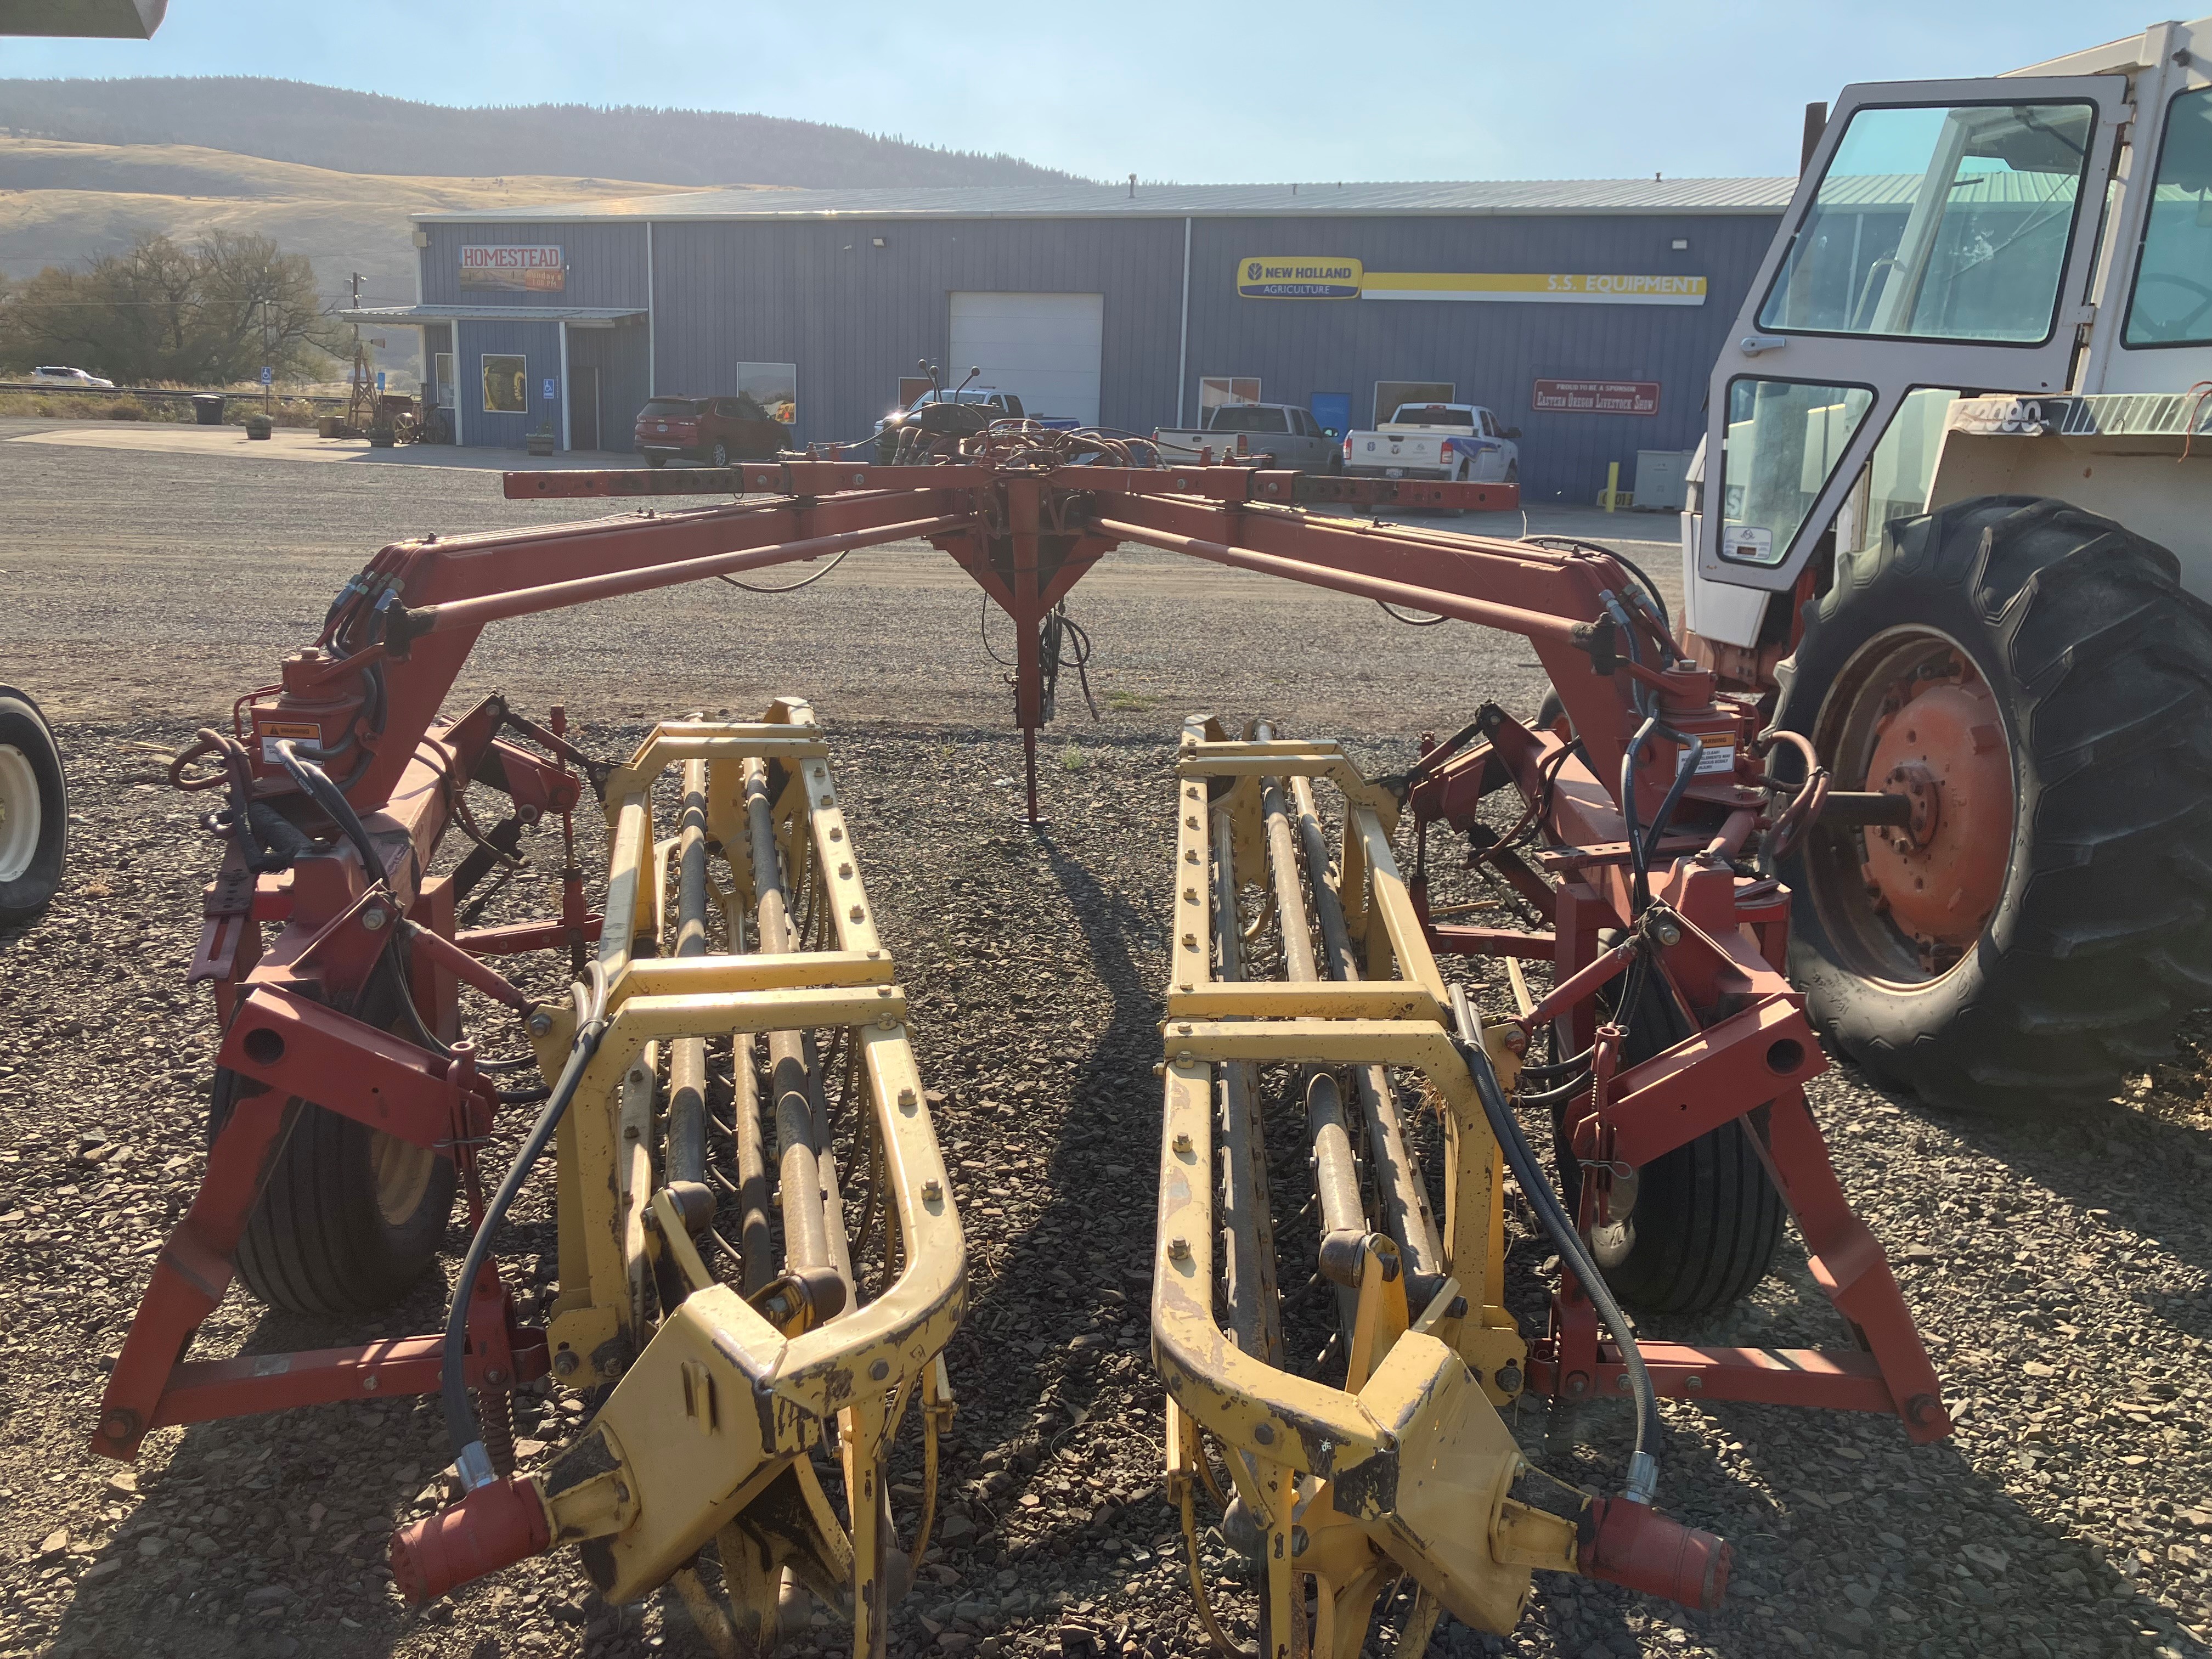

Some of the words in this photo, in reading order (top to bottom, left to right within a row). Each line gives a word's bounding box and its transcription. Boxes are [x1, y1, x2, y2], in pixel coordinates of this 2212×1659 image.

[464, 249, 558, 267] HOMESTEAD
[1266, 267, 1293, 278] NEW
[1295, 267, 1352, 279] HOLLAND
[1263, 285, 1330, 294] AGRICULTURE
[1548, 275, 1577, 291] S.S.
[1585, 275, 1702, 293] EQUIPMENT
[1605, 385, 1637, 393] SPONSOR
